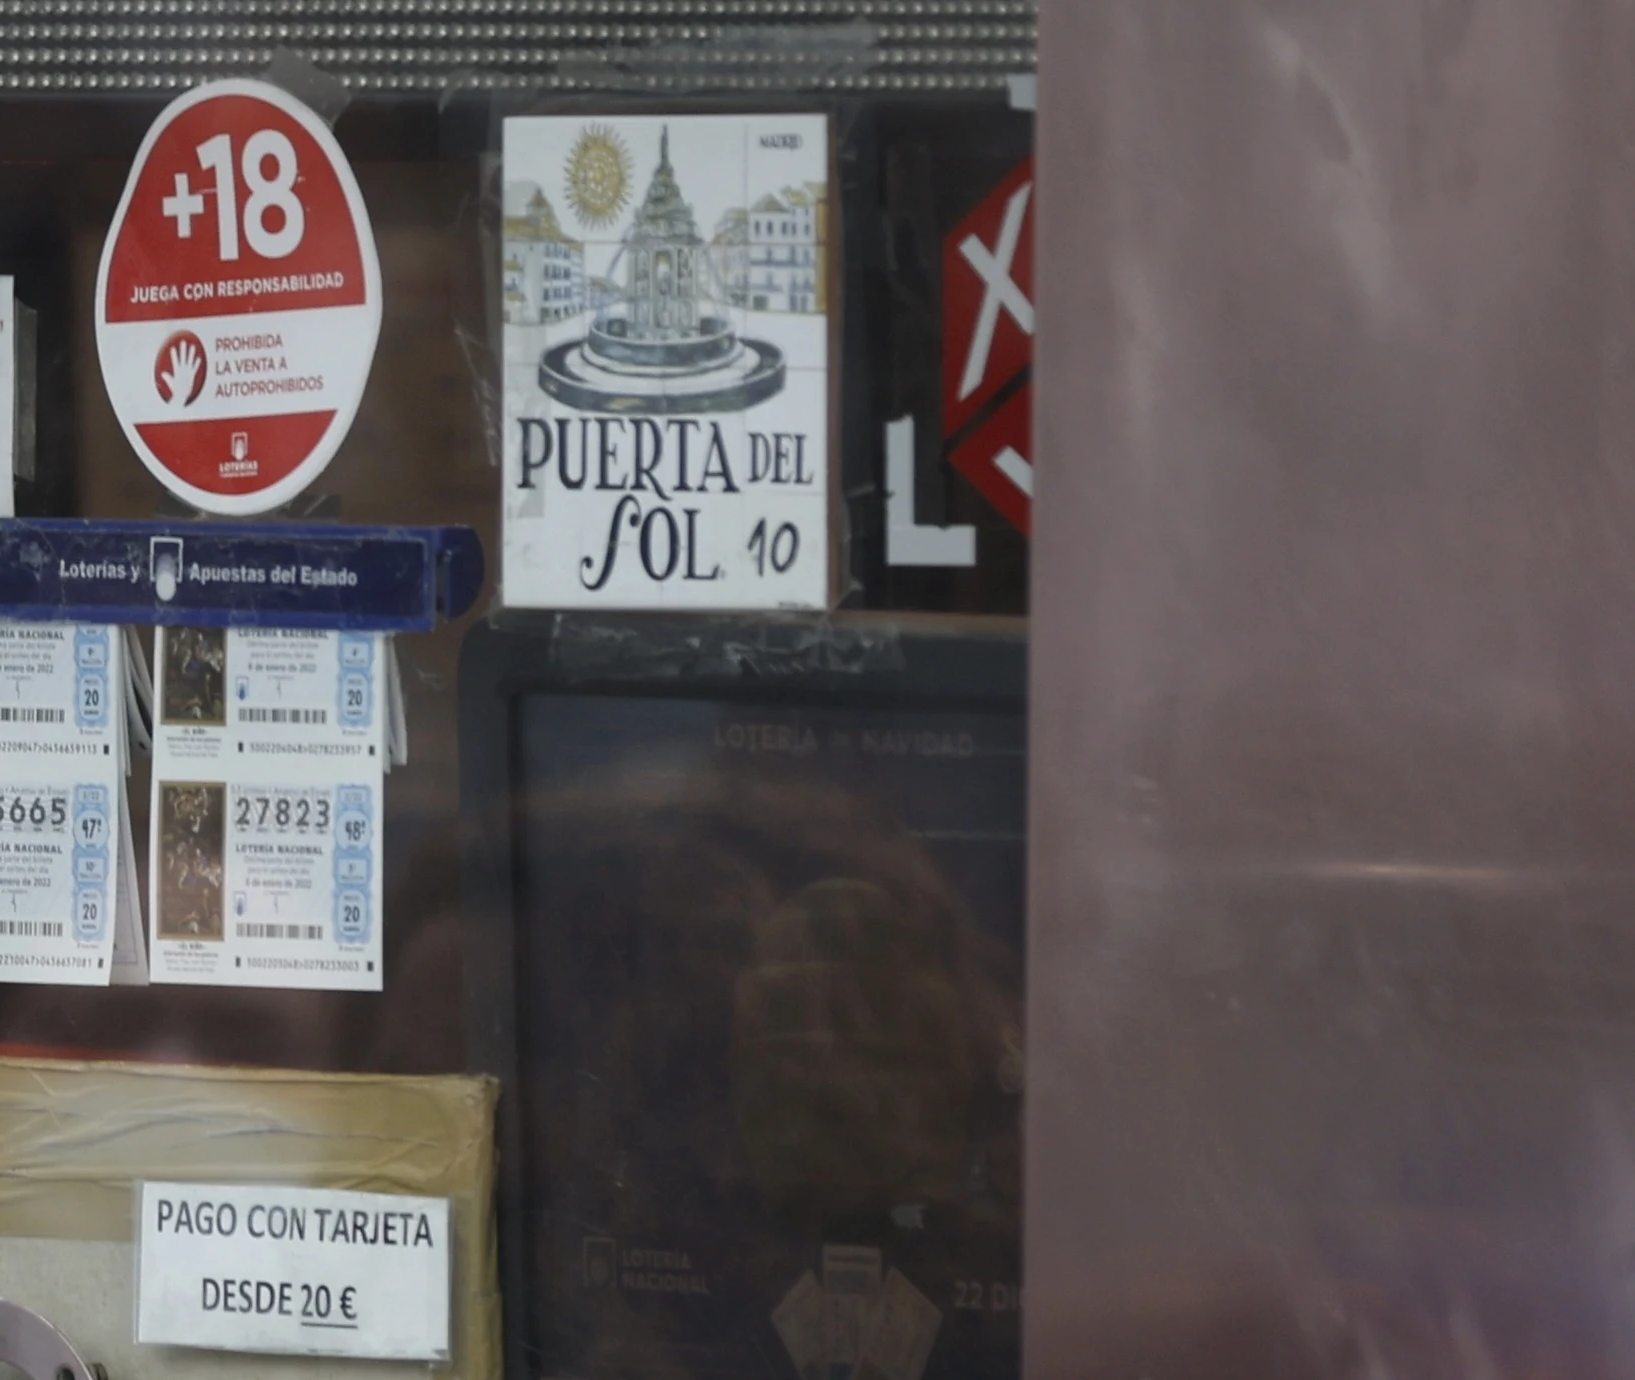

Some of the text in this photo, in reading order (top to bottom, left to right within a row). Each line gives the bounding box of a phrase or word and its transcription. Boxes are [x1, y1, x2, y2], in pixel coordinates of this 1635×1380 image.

[162, 129, 305, 261] +18
[130, 272, 344, 304] JUEGA CON RESPONSABILIDAD
[216, 334, 283, 352] PROHIBIDA
[216, 356, 288, 375] LA VENTA A
[216, 376, 324, 398] AUTOPROHIBIDOS
[516, 416, 814, 502] PUERTA DEL
[580, 494, 721, 591] SOL
[747, 517, 801, 578] 10
[59, 559, 358, 587] Loterías y Apuestas del Estado
[84, 689, 100, 706] 20
[236, 797, 331, 829] 27823
[82, 903, 98, 921] 20
[343, 905, 361, 923] 20
[156, 1199, 435, 1248] PAGO CON TARJETA
[202, 1277, 358, 1321] DESDE 20 €
[990, 1281, 1022, 1311] DI
